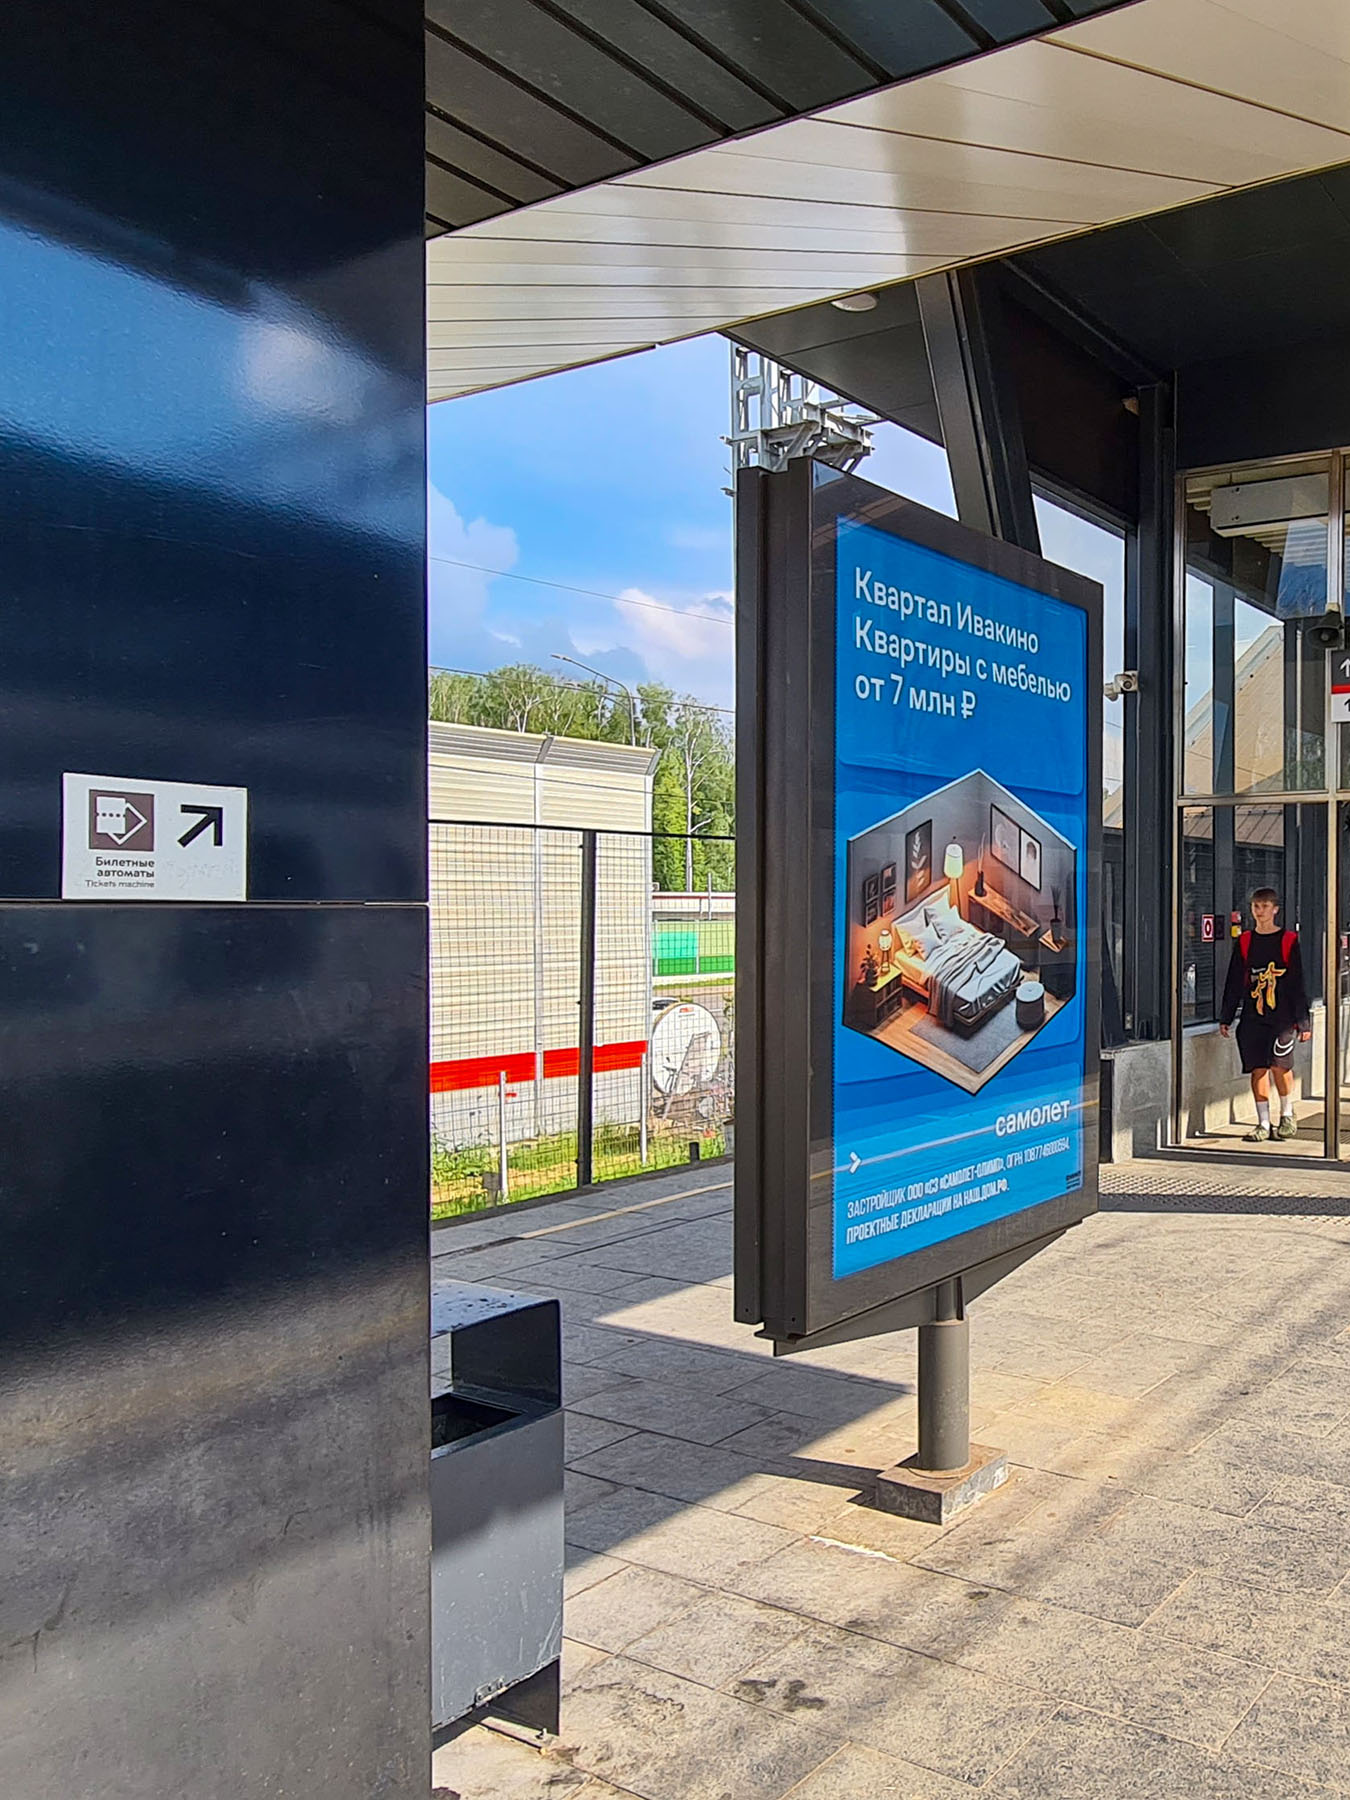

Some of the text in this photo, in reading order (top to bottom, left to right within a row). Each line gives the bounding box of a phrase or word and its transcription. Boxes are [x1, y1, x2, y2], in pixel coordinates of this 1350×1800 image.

[855, 567, 1039, 654] Квартал Ивакино
[855, 616, 1071, 702] Квартиры с мебелью
[855, 675, 885, 701] от
[890, 673, 903, 705] 7
[909, 687, 956, 717] млн
[95, 856, 155, 868] Билетные
[97, 869, 154, 878] автоматы
[118, 880, 154, 888] machine
[995, 1099, 1071, 1137] самолет
[847, 1186, 906, 1218] ЗАСТРОЙЩИК
[907, 1182, 924, 1201] ООО
[1006, 1153, 1024, 1169] ОГРН
[846, 1213, 900, 1245] ПРОЕКТНЫЕ
[900, 1196, 952, 1230] ДЕКЛАРАЦИИ
[953, 1193, 963, 1209] НА
